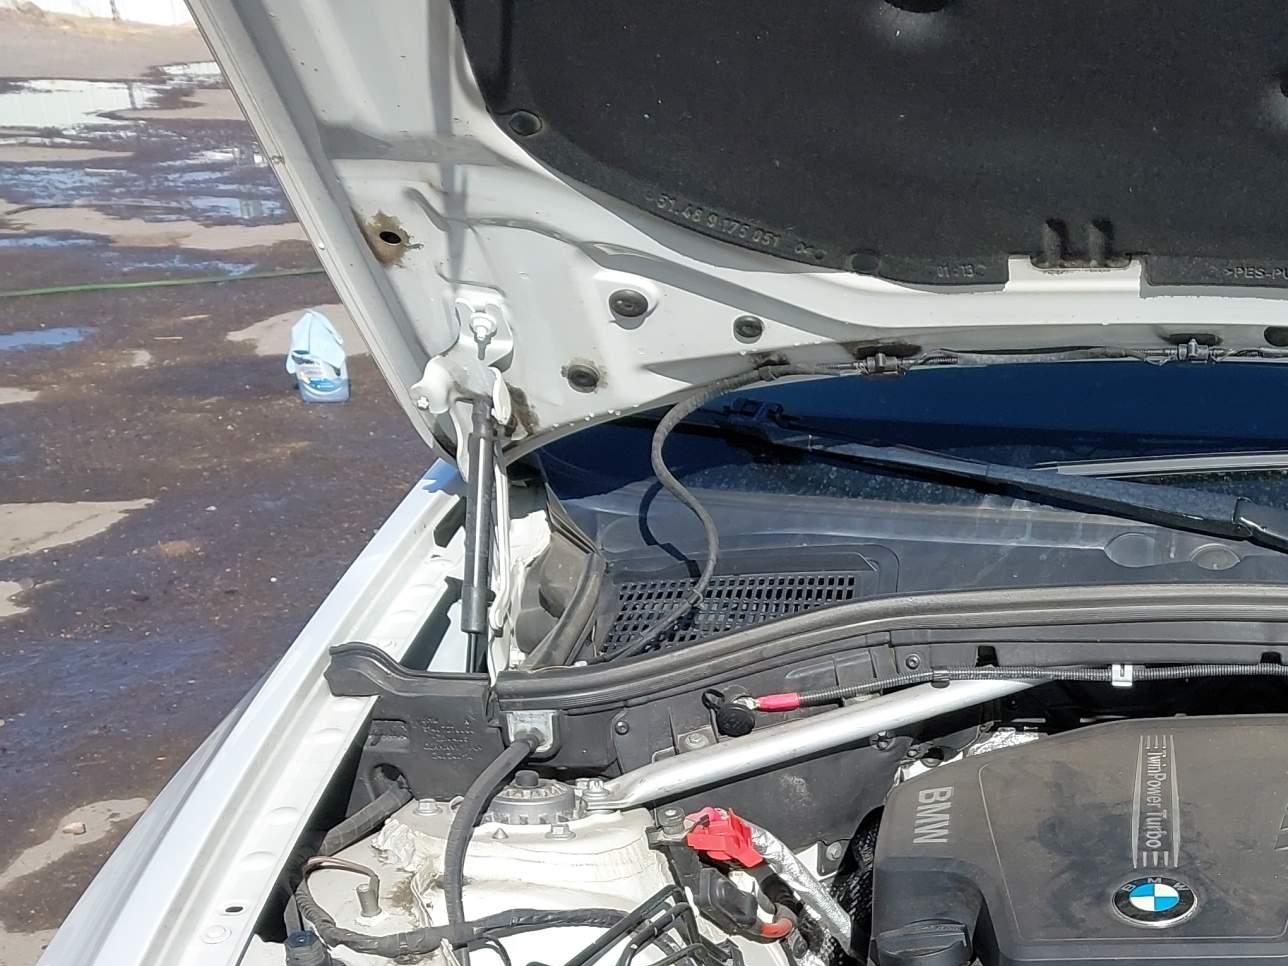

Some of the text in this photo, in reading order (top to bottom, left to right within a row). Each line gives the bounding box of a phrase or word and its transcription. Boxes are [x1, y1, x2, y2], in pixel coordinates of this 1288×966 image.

[913, 786, 953, 844] BMW
[1145, 750, 1167, 848] TwinPower Turbo
[1121, 876, 1189, 892] BMW
